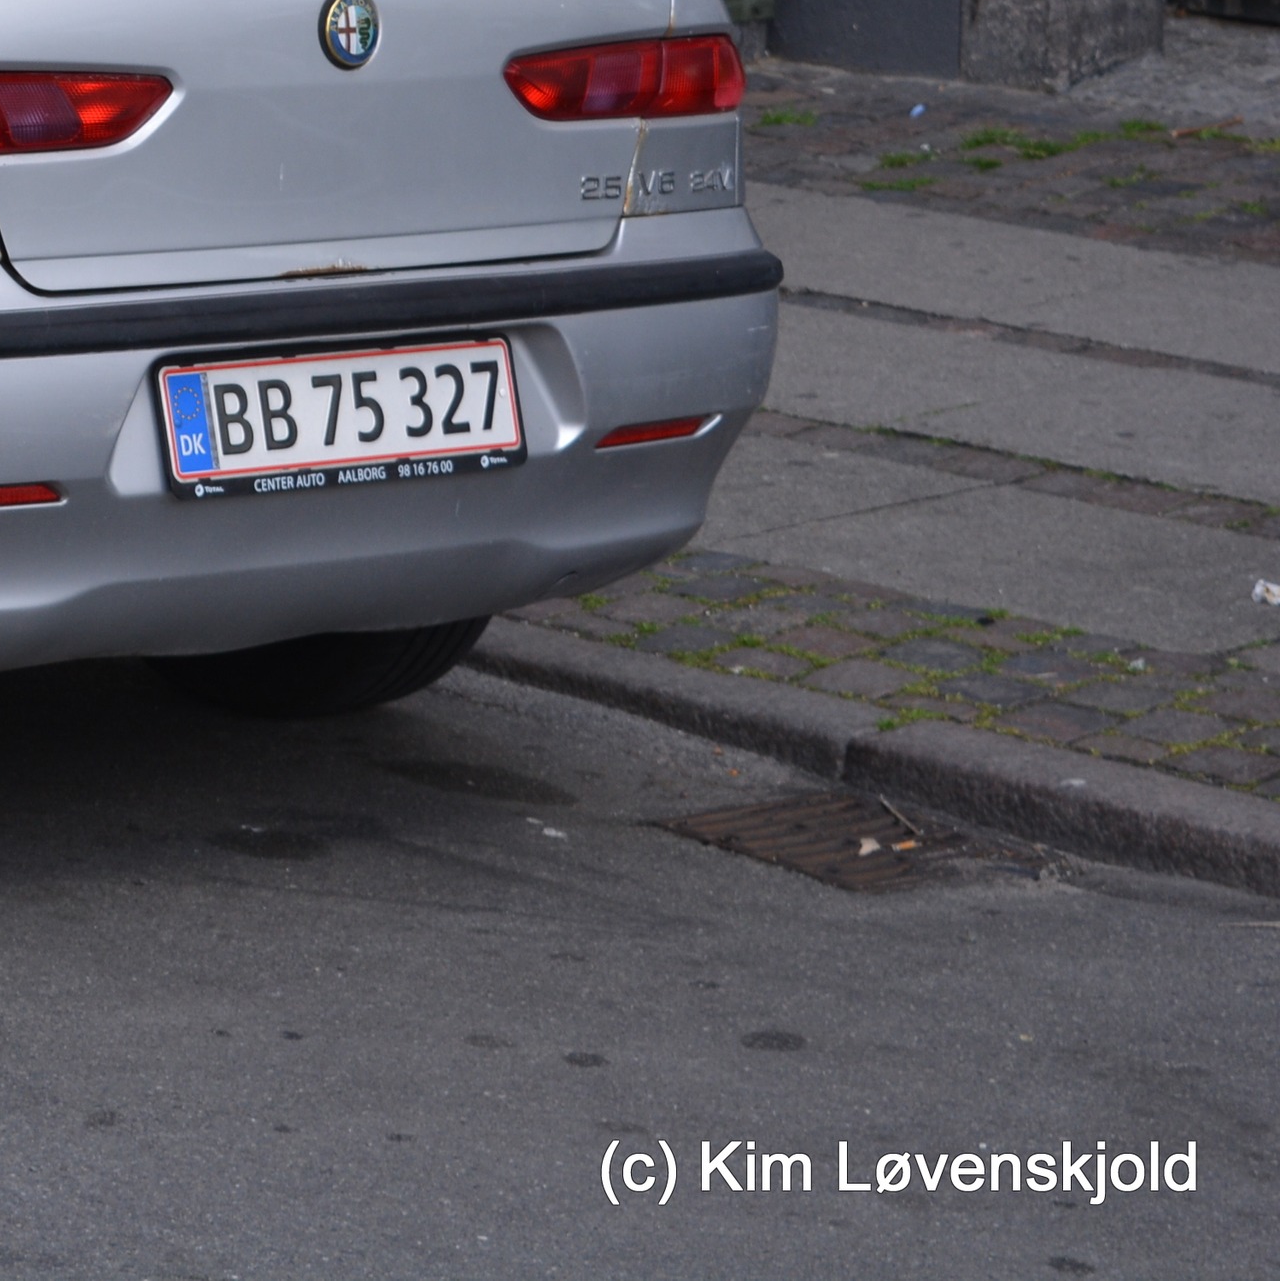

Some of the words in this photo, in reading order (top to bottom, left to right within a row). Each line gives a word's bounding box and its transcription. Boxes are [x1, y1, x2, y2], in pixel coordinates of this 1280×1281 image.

[638, 170, 675, 196] V6
[690, 168, 734, 193] 24V
[213, 379, 298, 456] BB
[311, 370, 385, 447] 75
[398, 360, 500, 438] 327
[180, 433, 206, 457] DK
[254, 478, 294, 492] CENTER
[296, 473, 325, 488] AUTO
[338, 466, 386, 484] AALBORG
[398, 463, 410, 478] 98
[413, 462, 425, 476] 16
[427, 461, 439, 475] 76
[440, 460, 453, 474] 00
